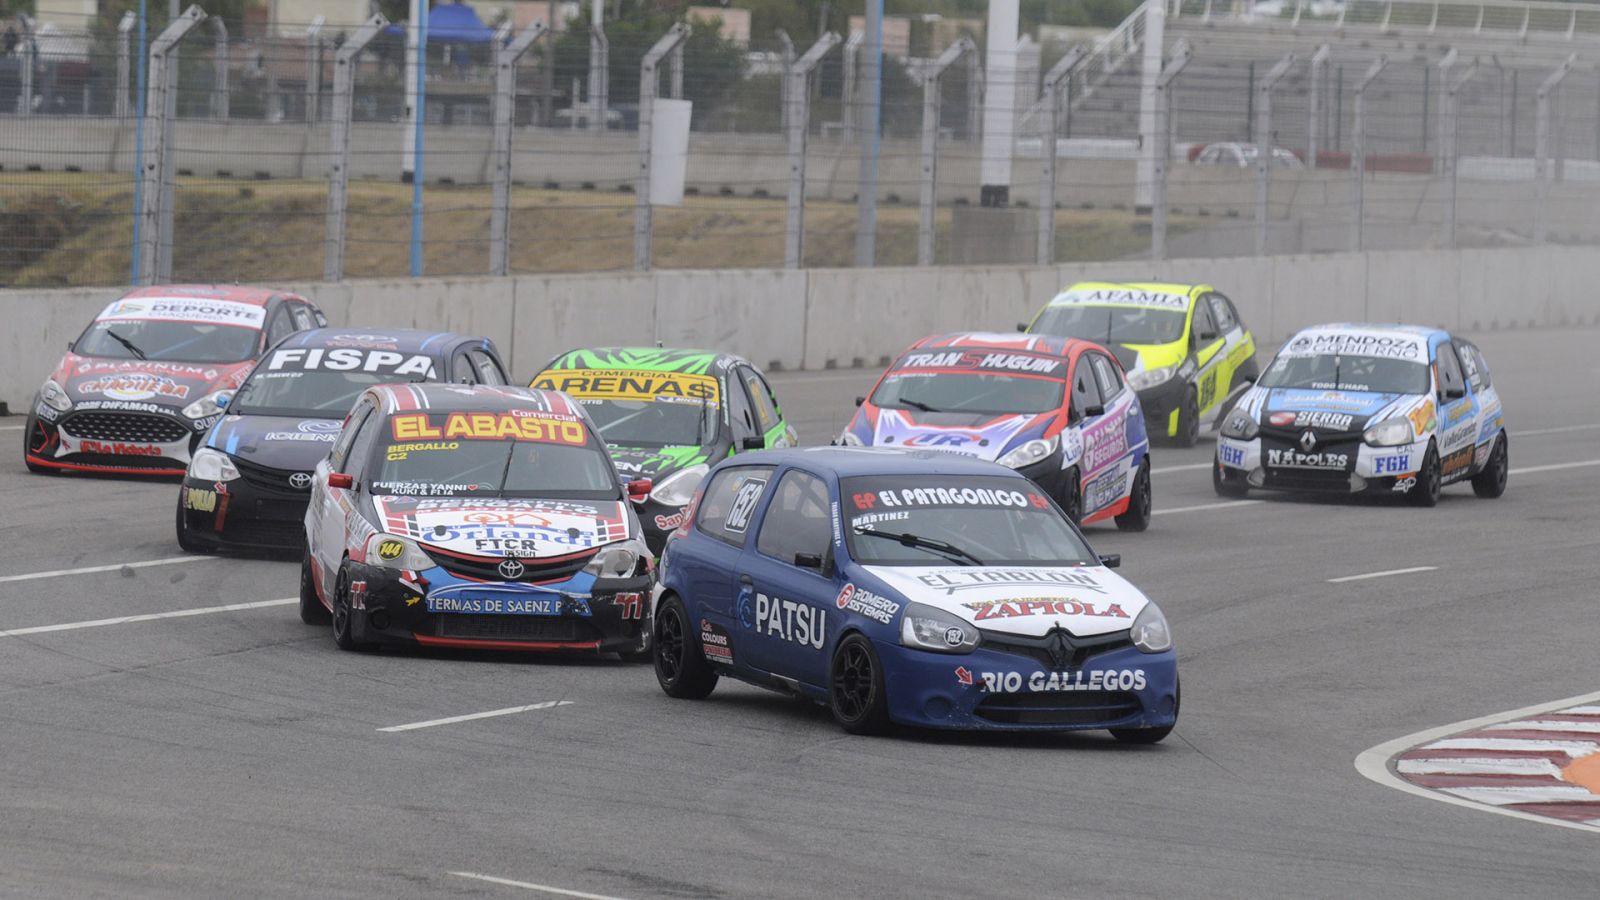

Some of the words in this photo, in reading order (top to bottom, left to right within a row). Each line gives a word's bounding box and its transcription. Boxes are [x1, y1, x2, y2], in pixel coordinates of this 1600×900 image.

[152, 304, 259, 320] DEPORTE
[1315, 335, 1419, 350] MENDOZA
[1313, 344, 1417, 359] GOBIERNO
[95, 361, 203, 374] PLATINUM
[268, 349, 436, 379] FISPA
[581, 371, 673, 379] COMERCIAL
[531, 377, 715, 399] ARENAS
[1338, 383, 1369, 391] CHAPA
[101, 401, 157, 413] DIFAMAQ
[512, 410, 577, 422] Comercial
[1297, 411, 1353, 426] SIERRA
[395, 416, 441, 438] EL
[447, 415, 584, 443] ABASTO
[388, 443, 459, 453] BERGALLO
[387, 453, 408, 461] C2
[1268, 448, 1347, 466] NÁPOLES
[1375, 455, 1408, 473] FGH
[373, 482, 428, 490] FUERZAS
[391, 488, 417, 496] KUKI
[727, 482, 763, 529] 152
[879, 491, 903, 507] EL
[904, 489, 1028, 508] PATAGONICO
[416, 501, 598, 515] BERGALLO
[853, 512, 909, 527] MARTINEZ
[423, 527, 594, 547] Orlandi
[380, 542, 403, 558] 144
[475, 539, 541, 551] FTCR
[917, 573, 961, 587] EL
[961, 571, 1100, 586] TABLON
[426, 598, 481, 613] TERMAS
[485, 599, 503, 612] DE
[506, 599, 552, 613] SAENZ
[854, 588, 900, 614] ROMERO
[847, 599, 893, 624] SISTEMAS
[974, 601, 1132, 621] ZAPIOLA
[756, 593, 826, 650] PATSU
[702, 632, 728, 645] COLOURS
[947, 630, 963, 645] 152
[981, 671, 1022, 693] RIO
[1029, 670, 1147, 693] GALLEGOS
